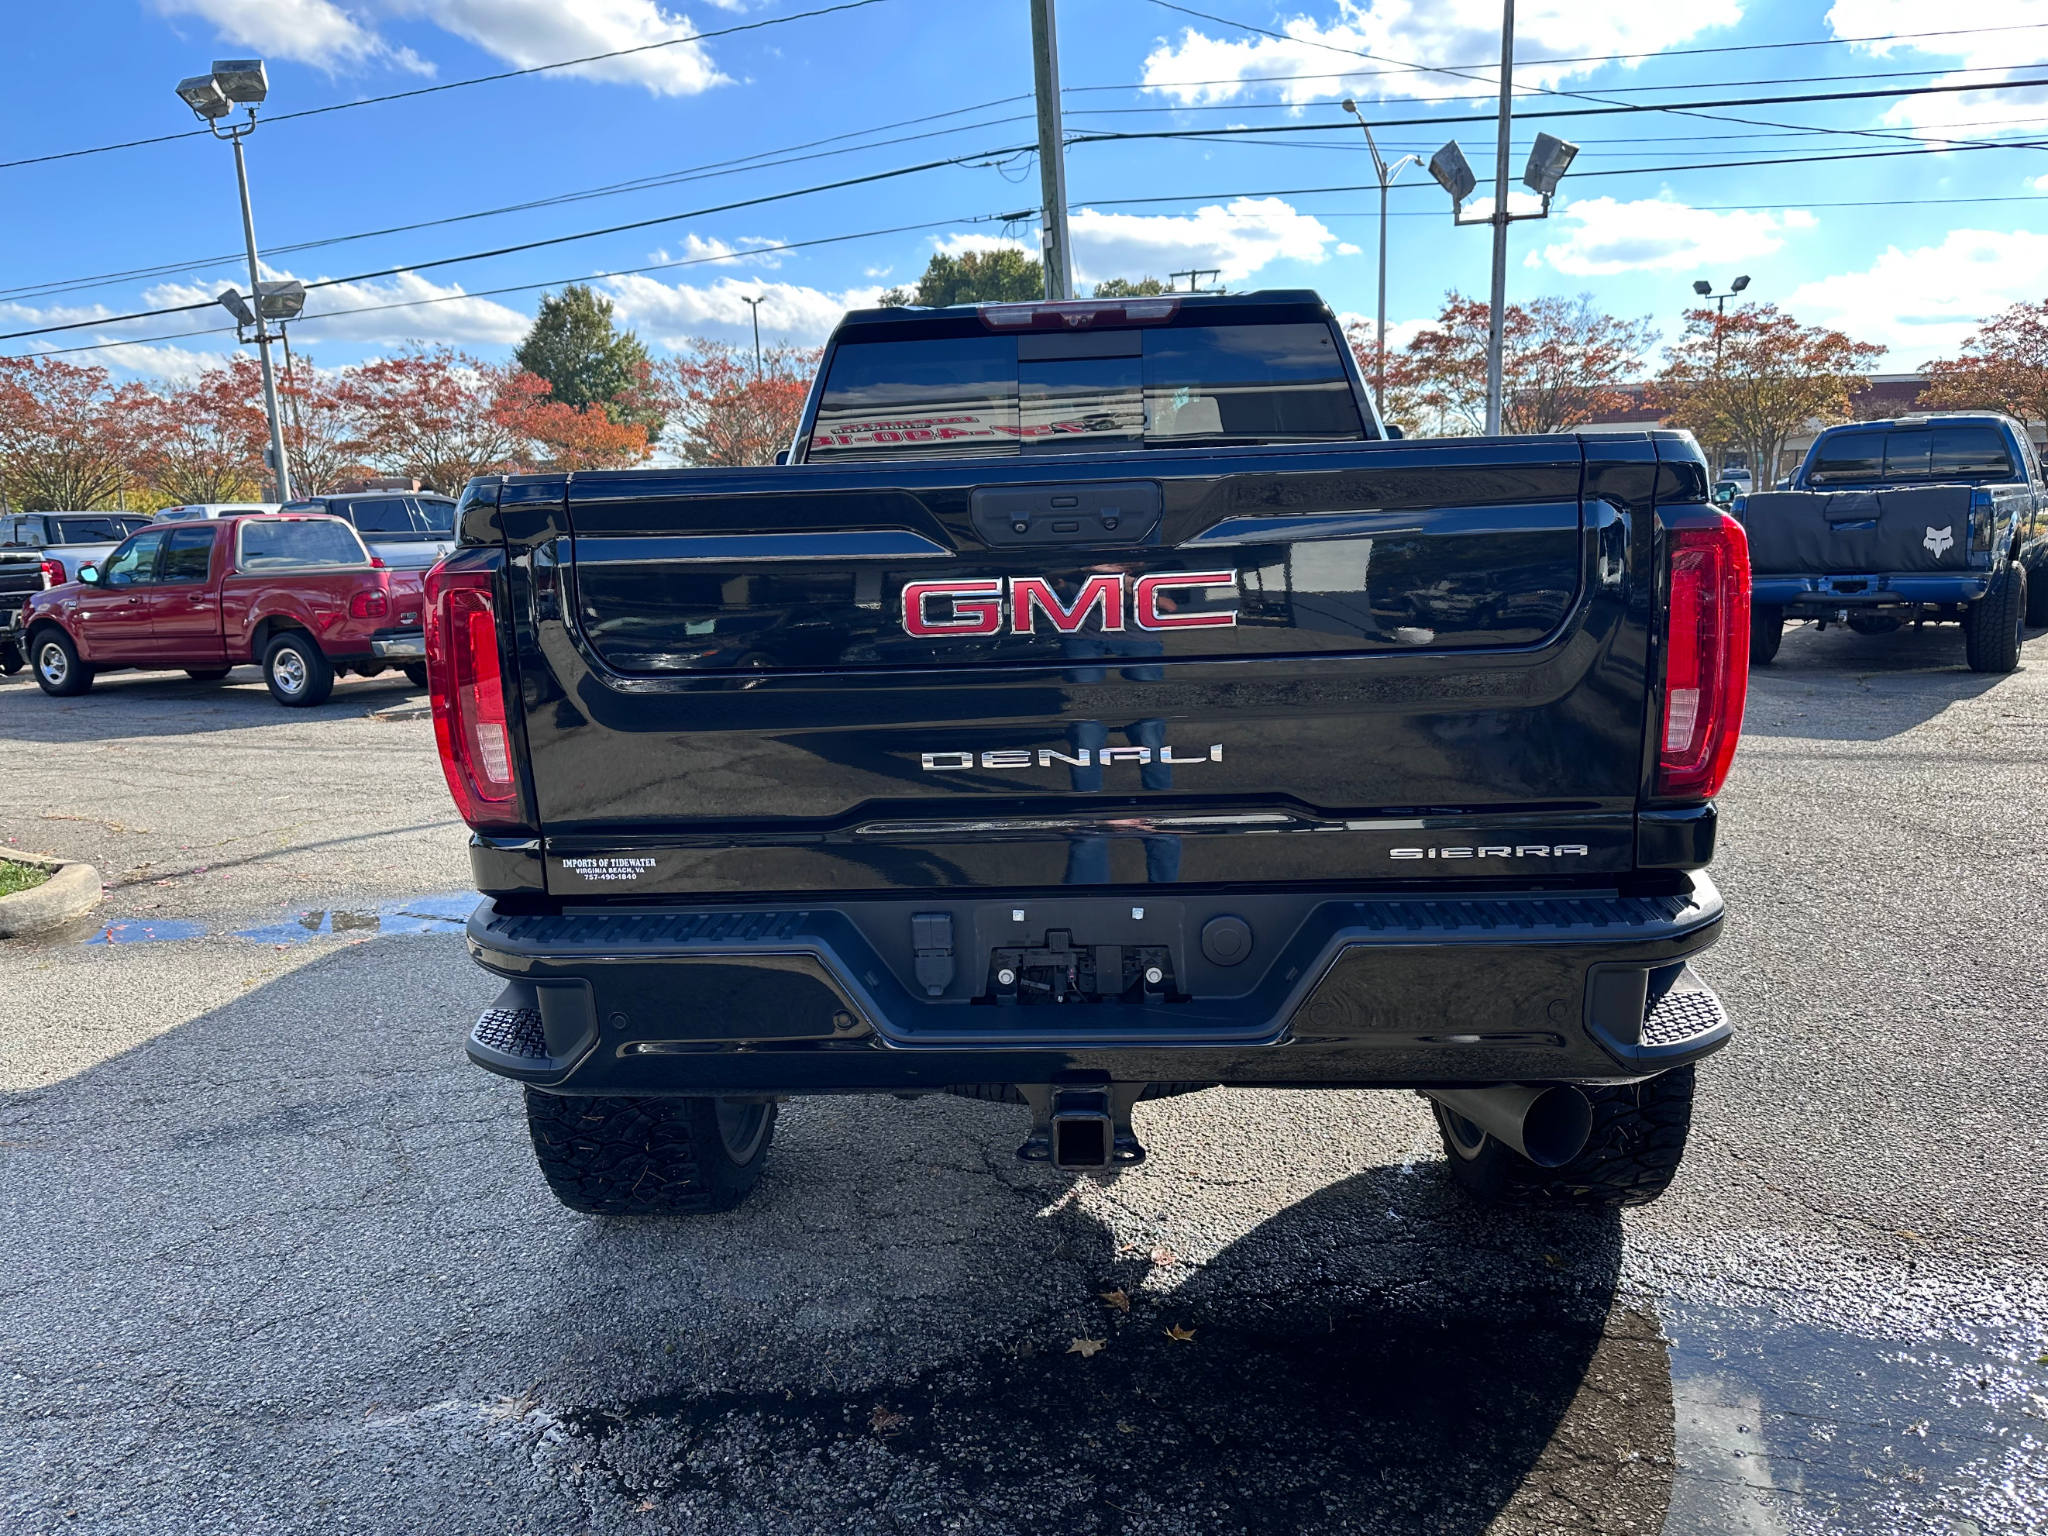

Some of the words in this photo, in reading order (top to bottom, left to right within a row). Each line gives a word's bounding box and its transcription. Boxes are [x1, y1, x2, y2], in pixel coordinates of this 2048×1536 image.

[901, 568, 1238, 638] GMC
[921, 744, 1223, 771] DENALI
[1389, 844, 1588, 860] SIERRA
[562, 859, 597, 868] IMPORTS
[598, 858, 609, 867] OF
[610, 858, 657, 867] TIDEWATER
